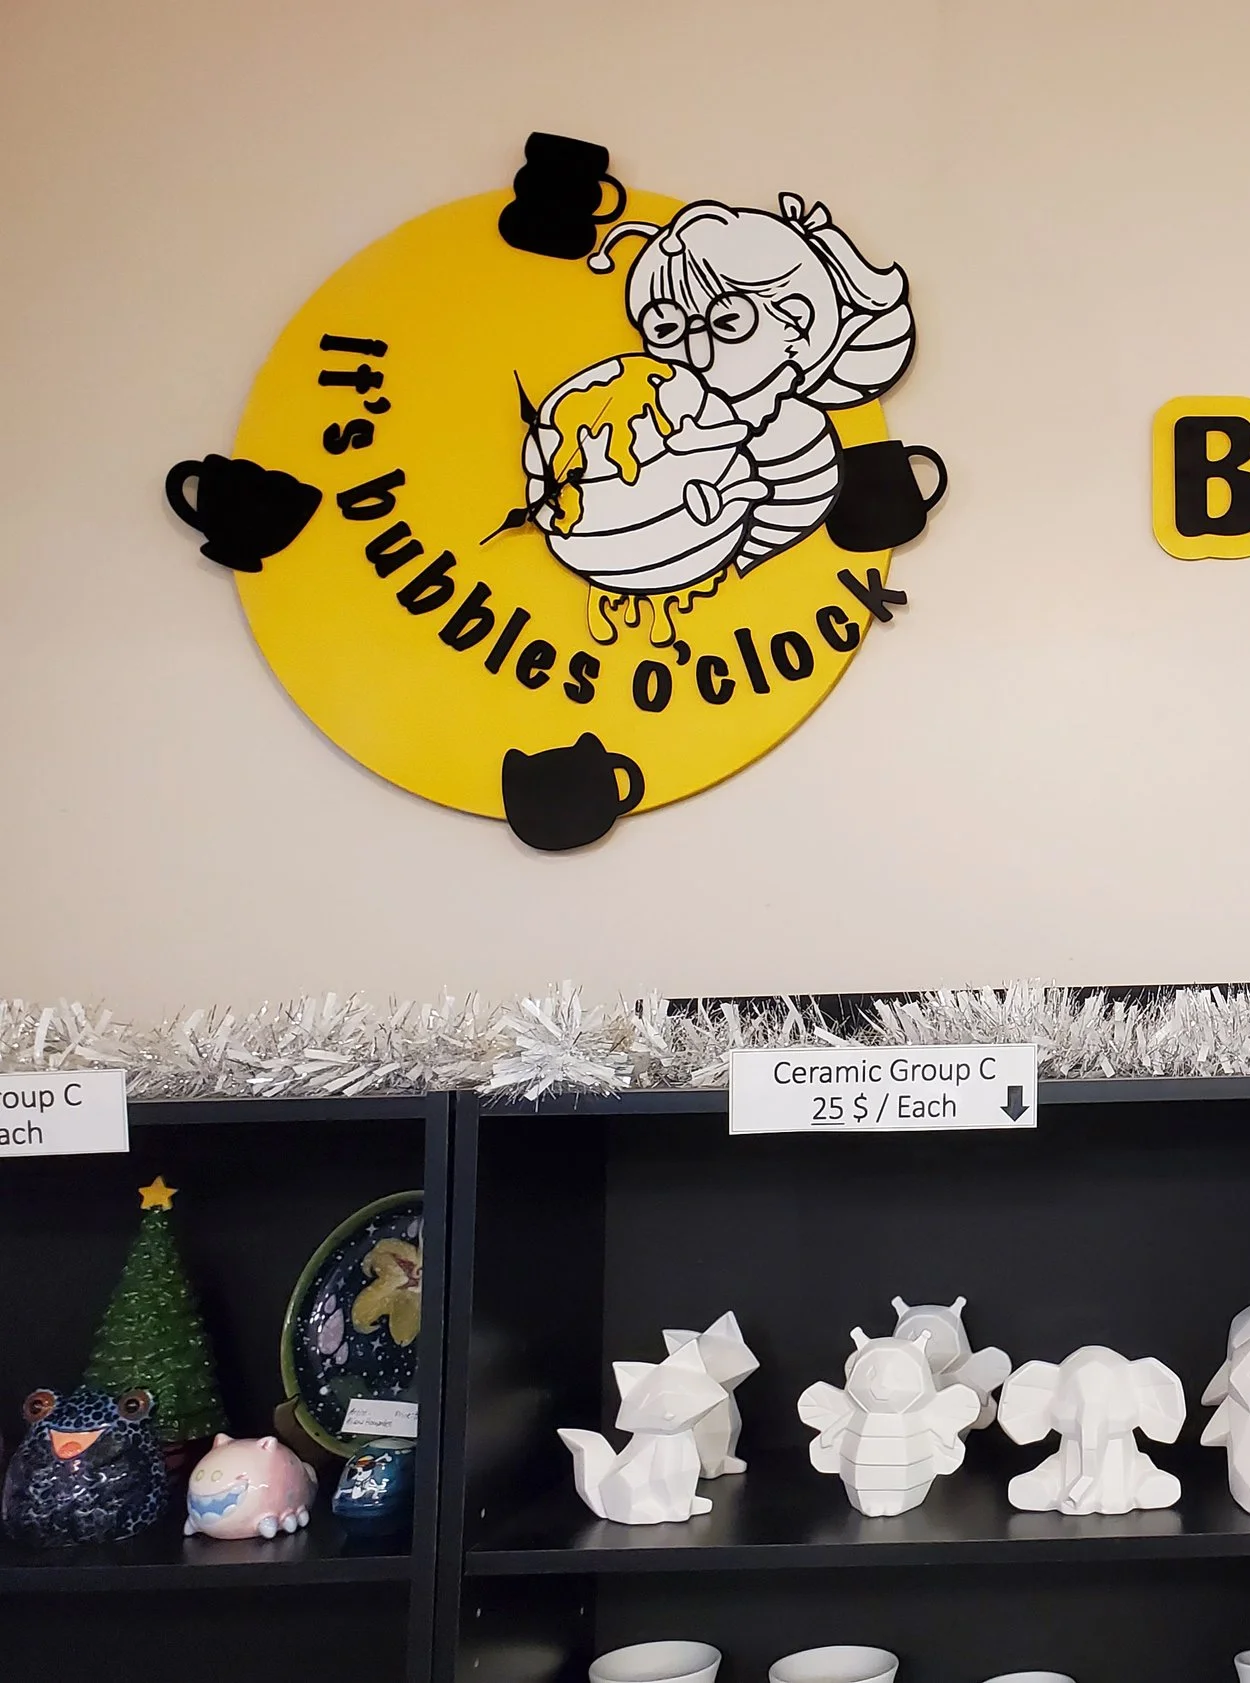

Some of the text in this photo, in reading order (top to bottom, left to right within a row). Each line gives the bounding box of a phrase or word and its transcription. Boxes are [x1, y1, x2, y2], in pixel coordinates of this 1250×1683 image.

[318, 334, 908, 713] It's bubbles o'clock
[773, 1057, 996, 1087] Ceramic Group C
[63, 1083, 82, 1107] C
[812, 1092, 956, 1124] 25 $ / Each
